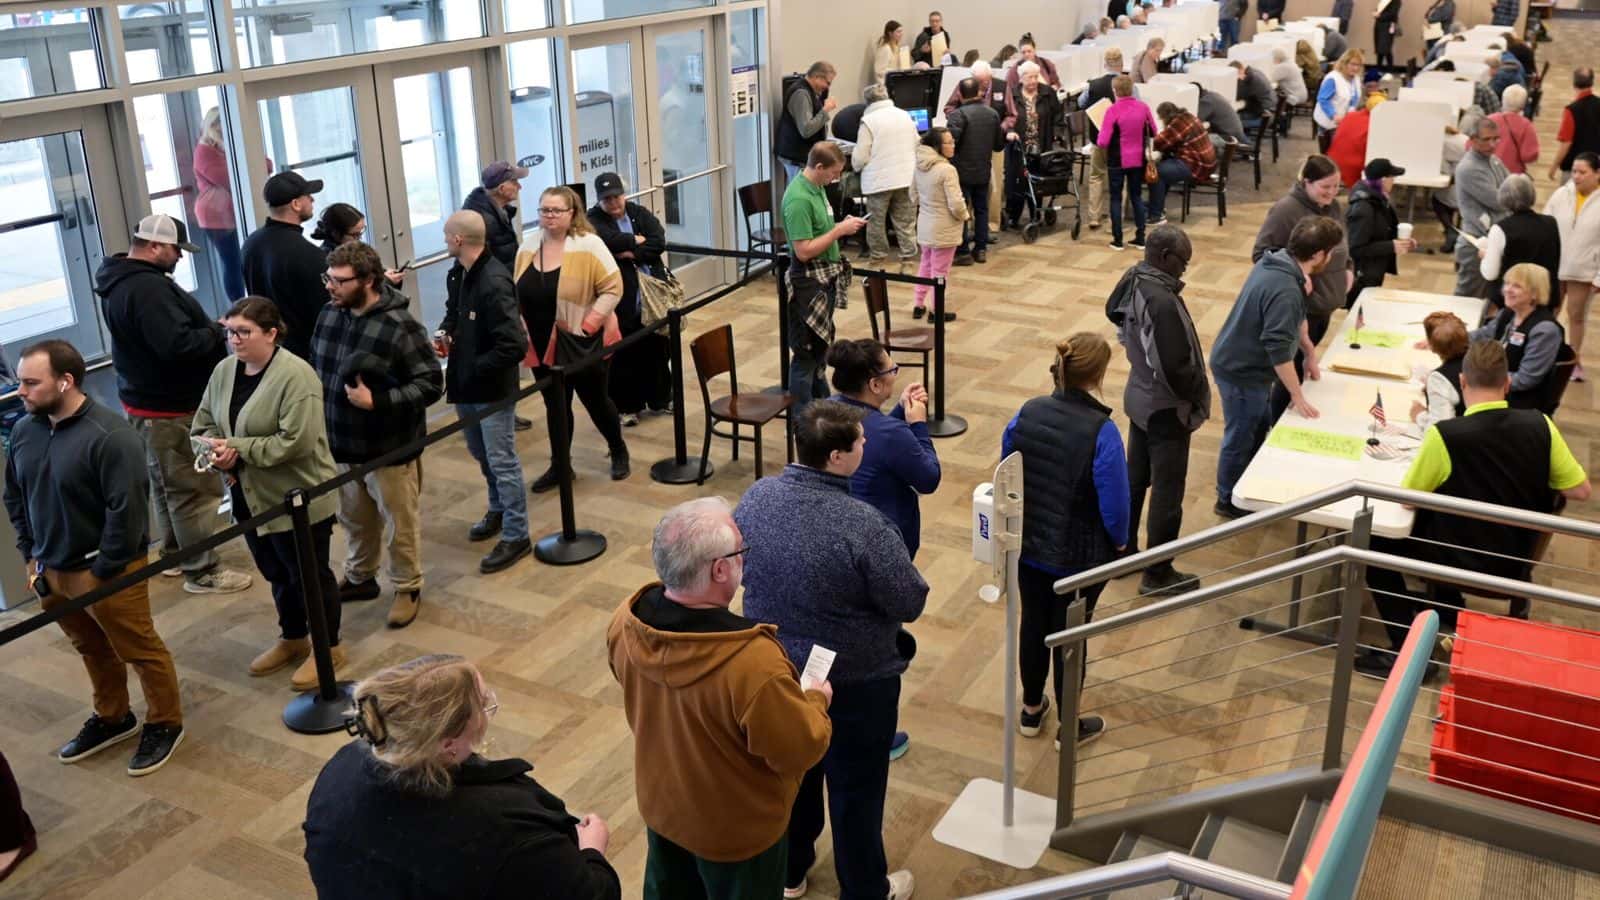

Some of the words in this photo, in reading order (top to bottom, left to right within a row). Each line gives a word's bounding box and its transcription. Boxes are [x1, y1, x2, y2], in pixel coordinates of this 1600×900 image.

[579, 138, 610, 154] milies
[580, 161, 587, 172] h
[590, 154, 613, 170] Kids
